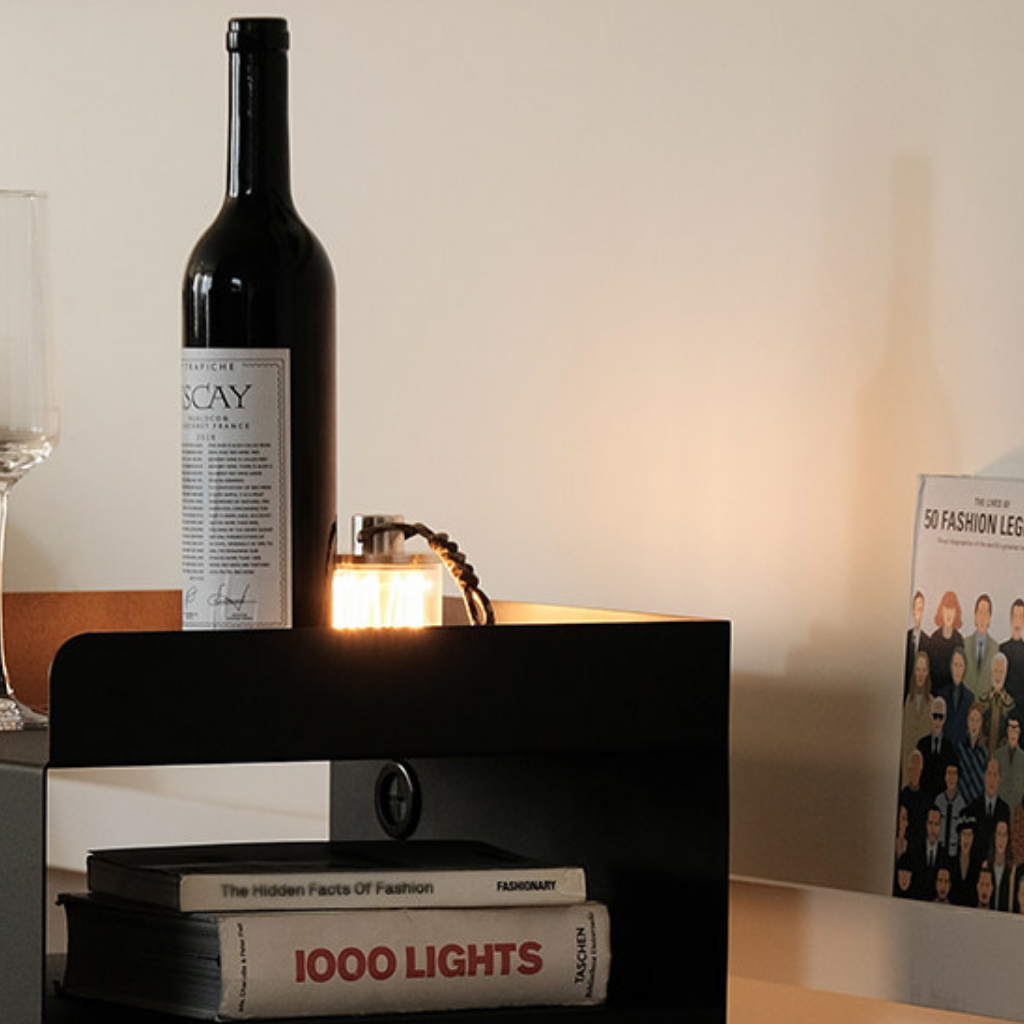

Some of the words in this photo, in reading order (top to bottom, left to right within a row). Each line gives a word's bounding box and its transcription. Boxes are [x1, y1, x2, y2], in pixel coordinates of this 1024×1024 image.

[924, 508, 939, 530] 50
[941, 509, 998, 535] FASHION
[1000, 513, 1024, 538] LEG
[221, 883, 249, 898] The
[252, 882, 306, 898] Hidden
[308, 881, 352, 897] Facts
[354, 880, 372, 896] Of
[375, 880, 435, 895] Fashion
[497, 880, 557, 892] FASHIONARY
[295, 946, 397, 983] 1000
[405, 941, 544, 979] LIGHTS
[575, 926, 587, 984] TASCHEN
